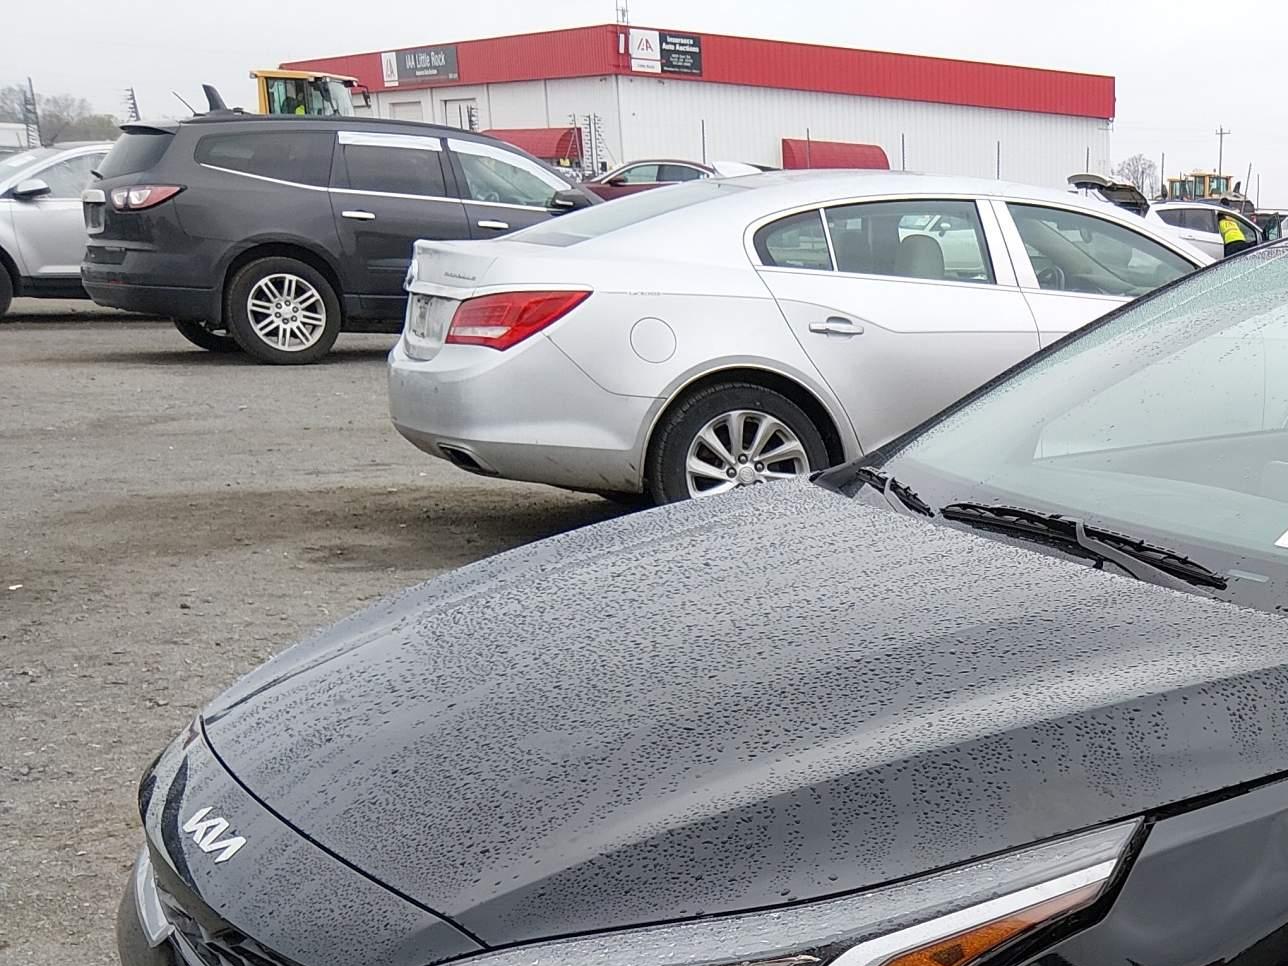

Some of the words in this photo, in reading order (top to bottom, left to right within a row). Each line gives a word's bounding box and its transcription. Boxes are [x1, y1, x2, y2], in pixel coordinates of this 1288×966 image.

[416, 53, 430, 68] Little
[431, 51, 446, 67] Rock
[183, 806, 247, 864] KIA
